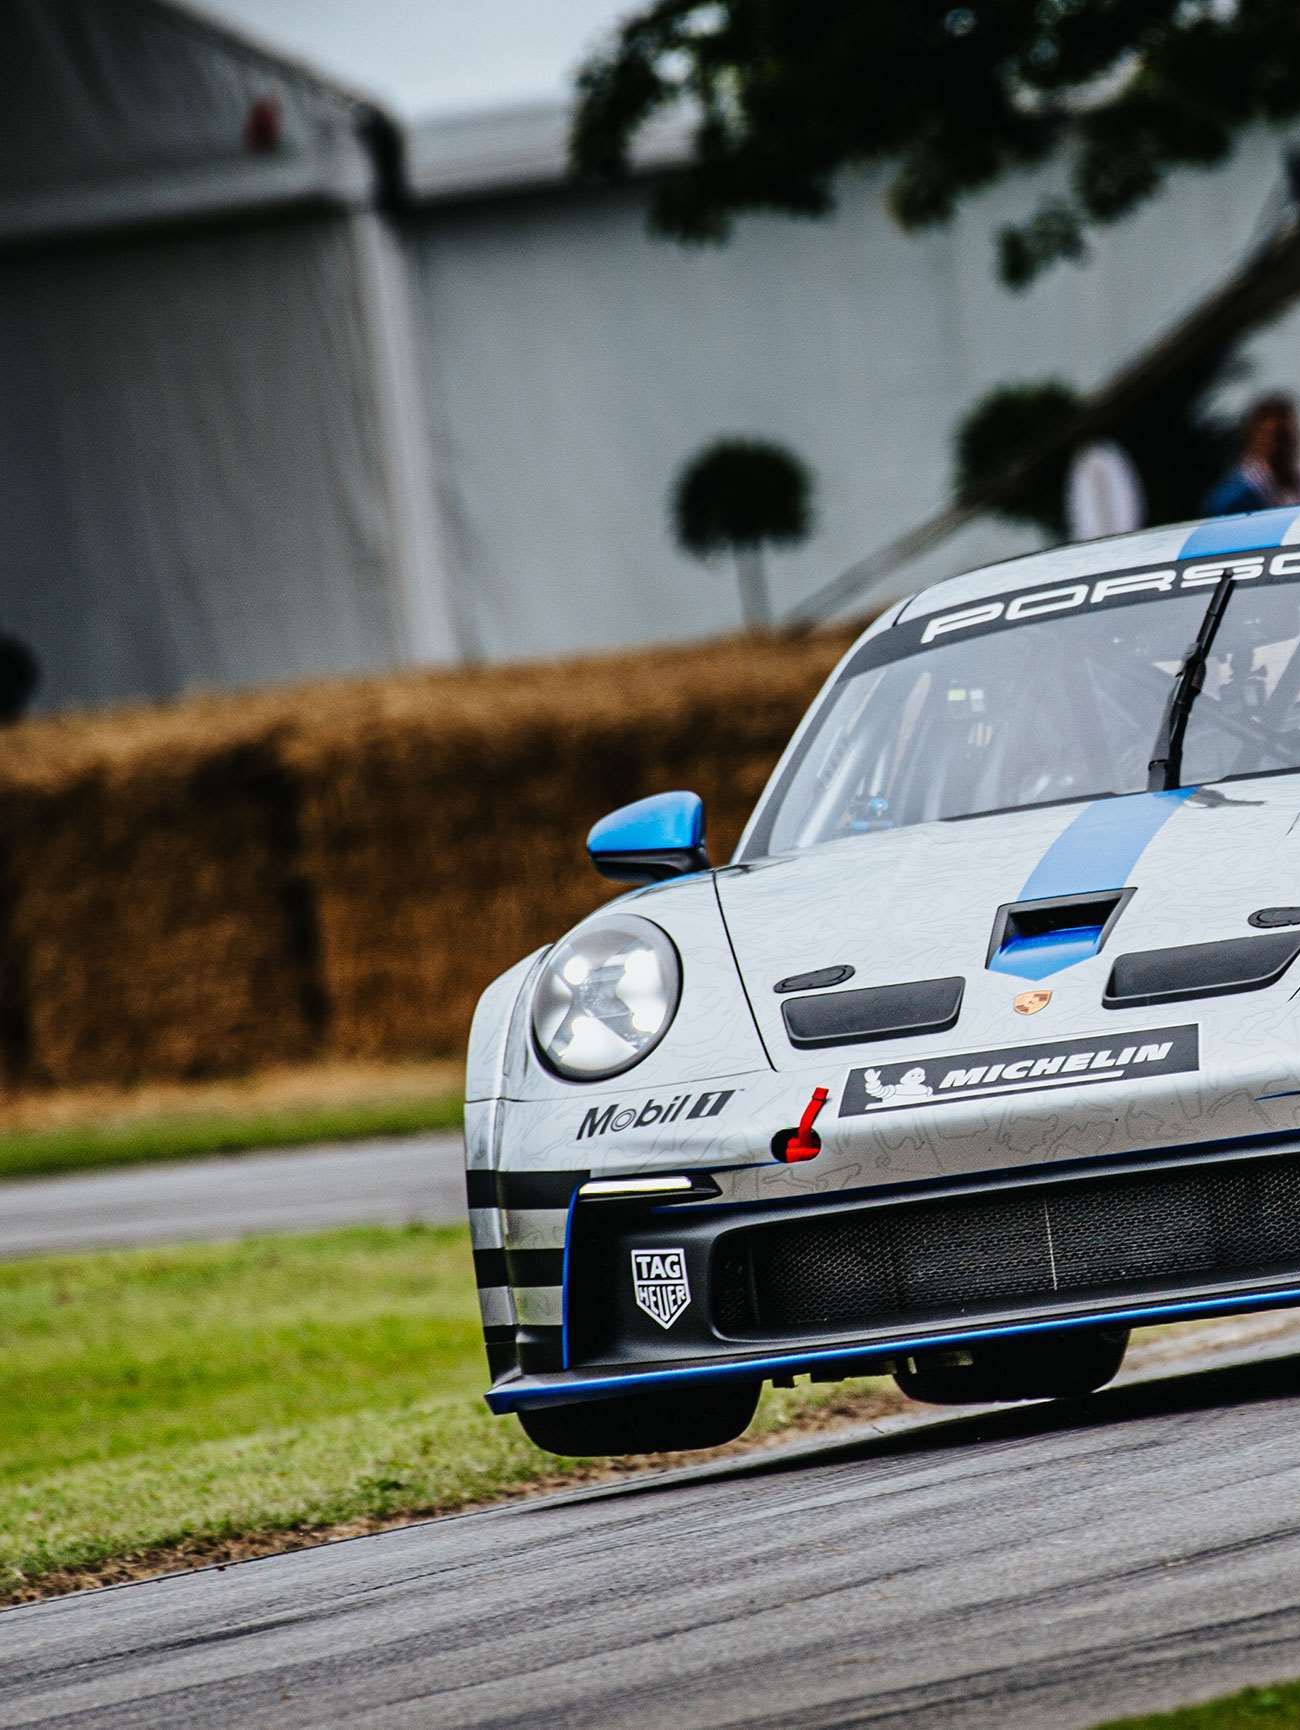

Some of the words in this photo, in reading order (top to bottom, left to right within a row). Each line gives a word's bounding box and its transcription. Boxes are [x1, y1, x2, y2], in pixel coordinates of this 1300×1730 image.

[938, 1042, 1174, 1090] MICHELIN
[576, 1094, 693, 1141] Mobil
[696, 1091, 728, 1118] 1
[636, 1254, 682, 1279] TAG
[638, 1285, 687, 1322] HEUER
